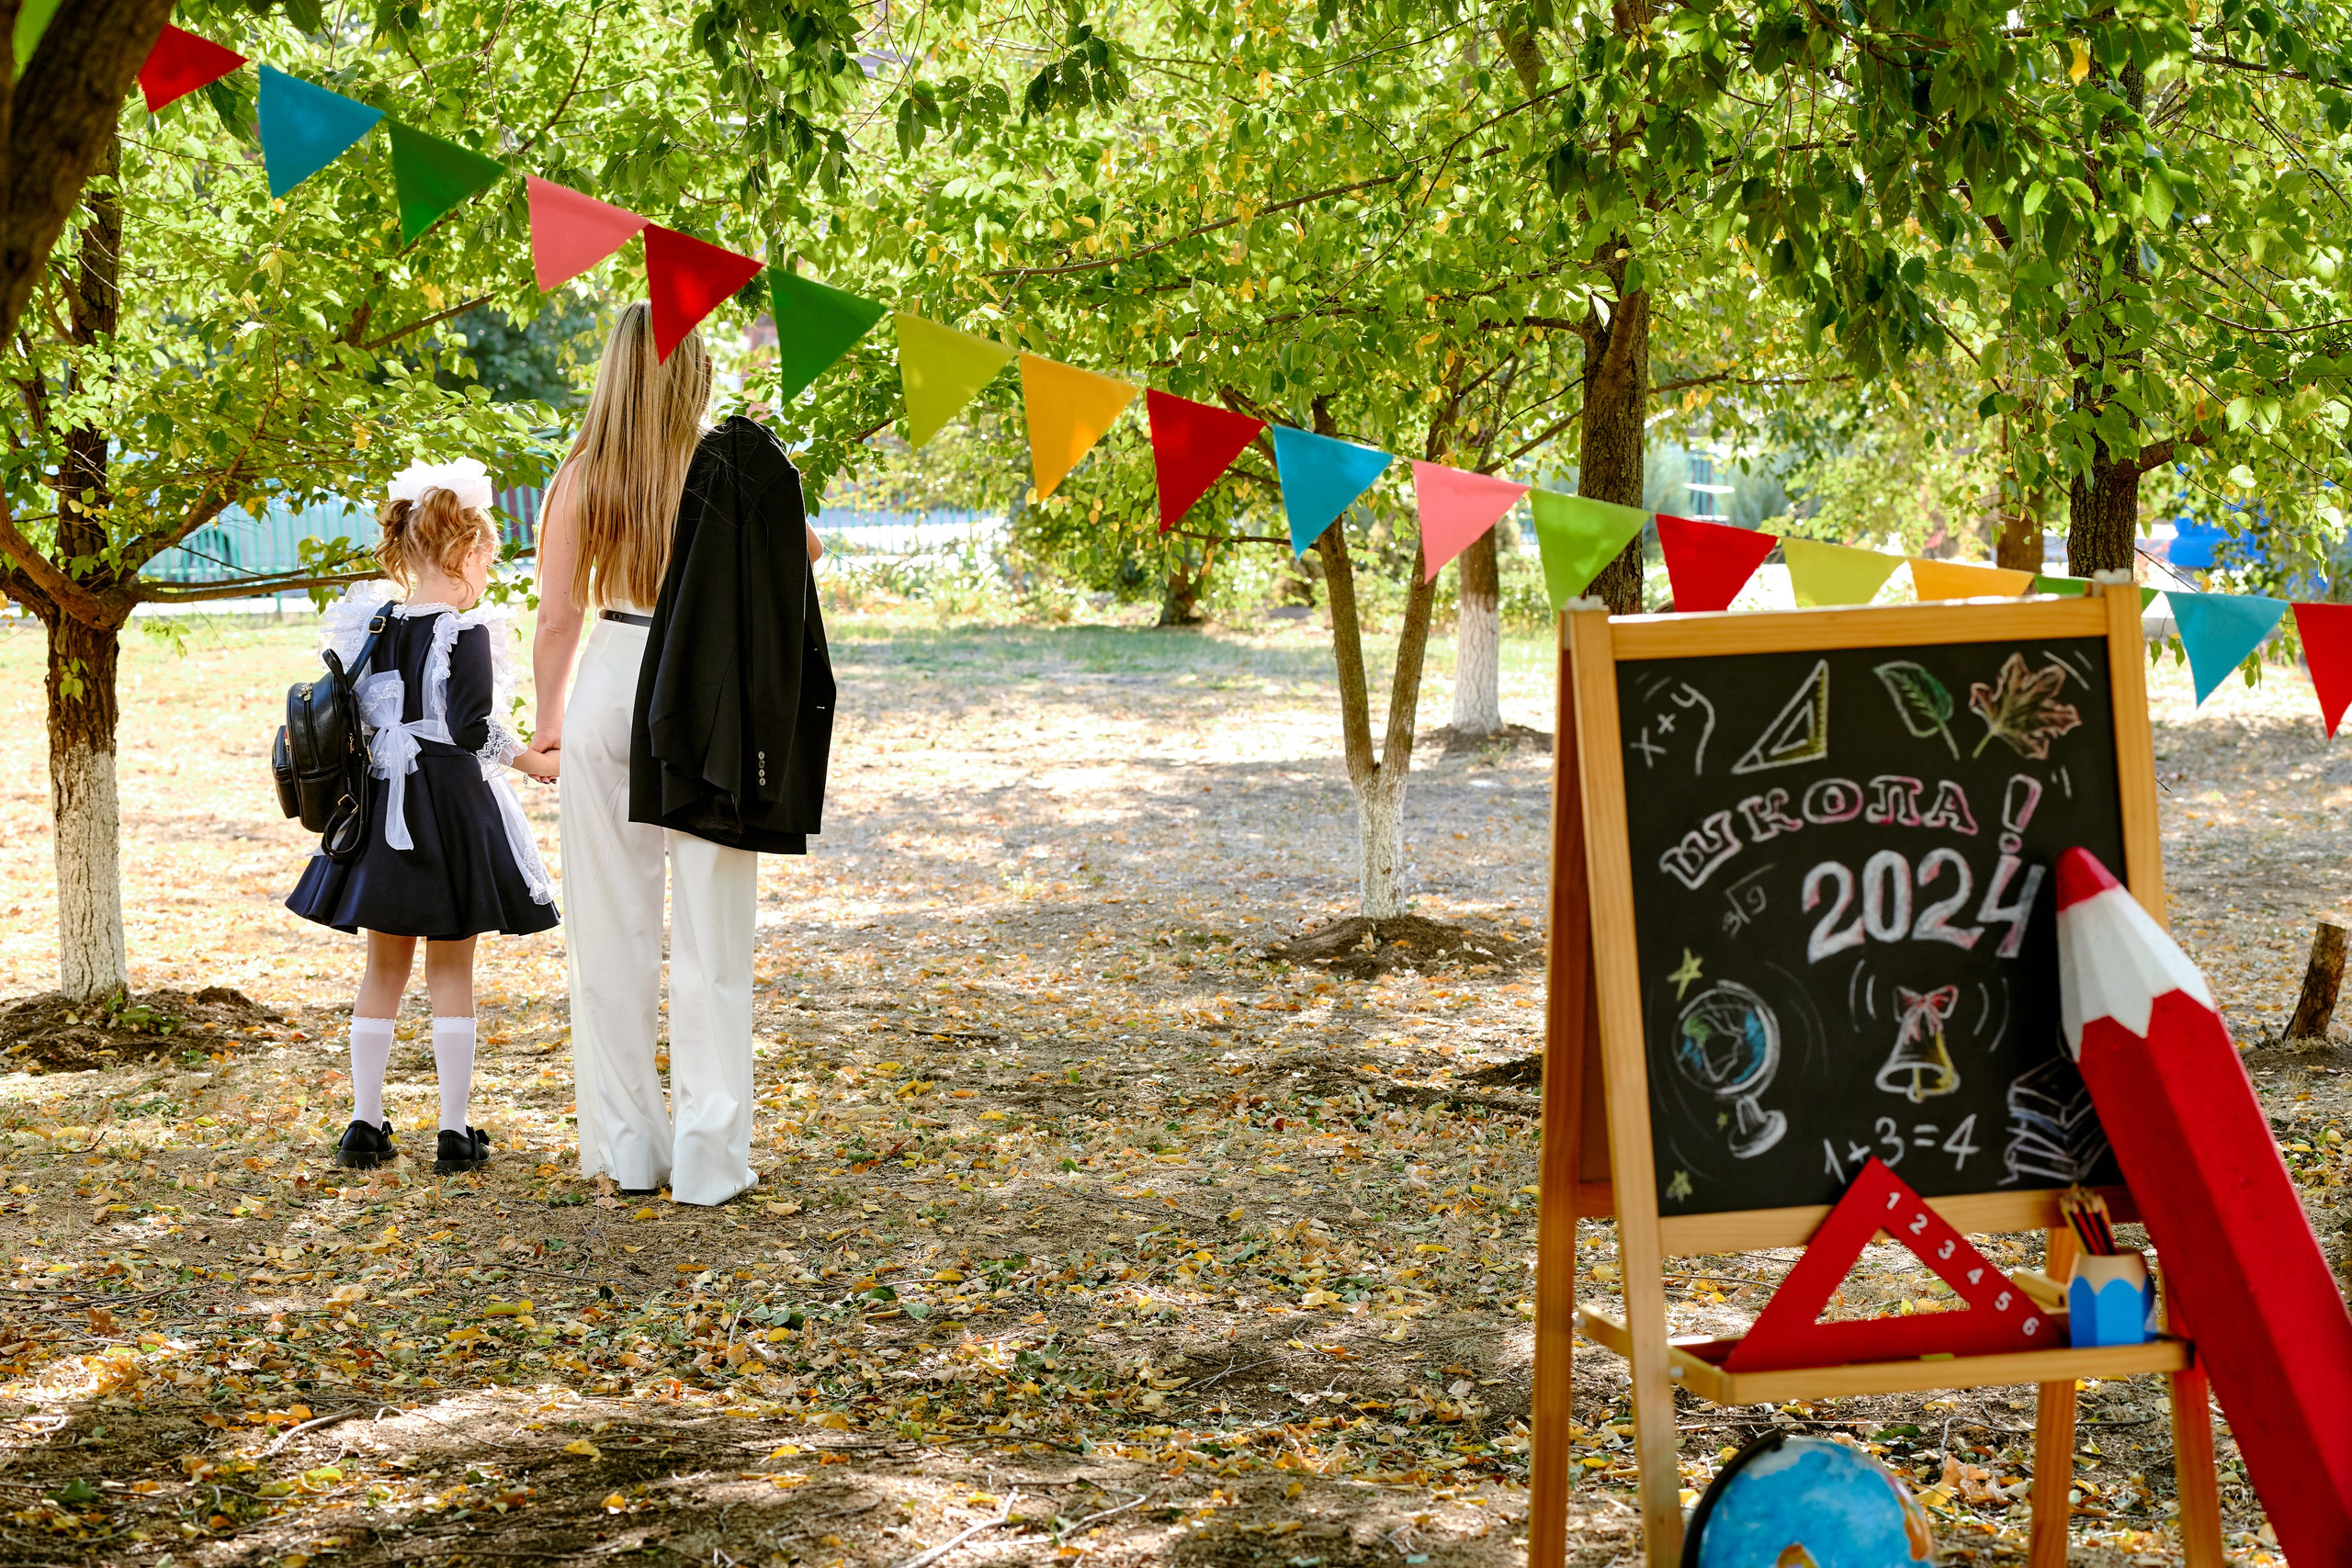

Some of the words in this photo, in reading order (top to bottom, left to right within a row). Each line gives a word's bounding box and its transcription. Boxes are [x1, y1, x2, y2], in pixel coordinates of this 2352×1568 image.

[1802, 848, 2046, 964] 2024
[1887, 1191, 1900, 1210] 1
[1910, 1213, 1927, 1235] 2
[1939, 1239, 1955, 1260] 3
[1968, 1268, 1983, 1285] 4
[1995, 1291, 2011, 1312] 5
[2023, 1316, 2039, 1337] 6
